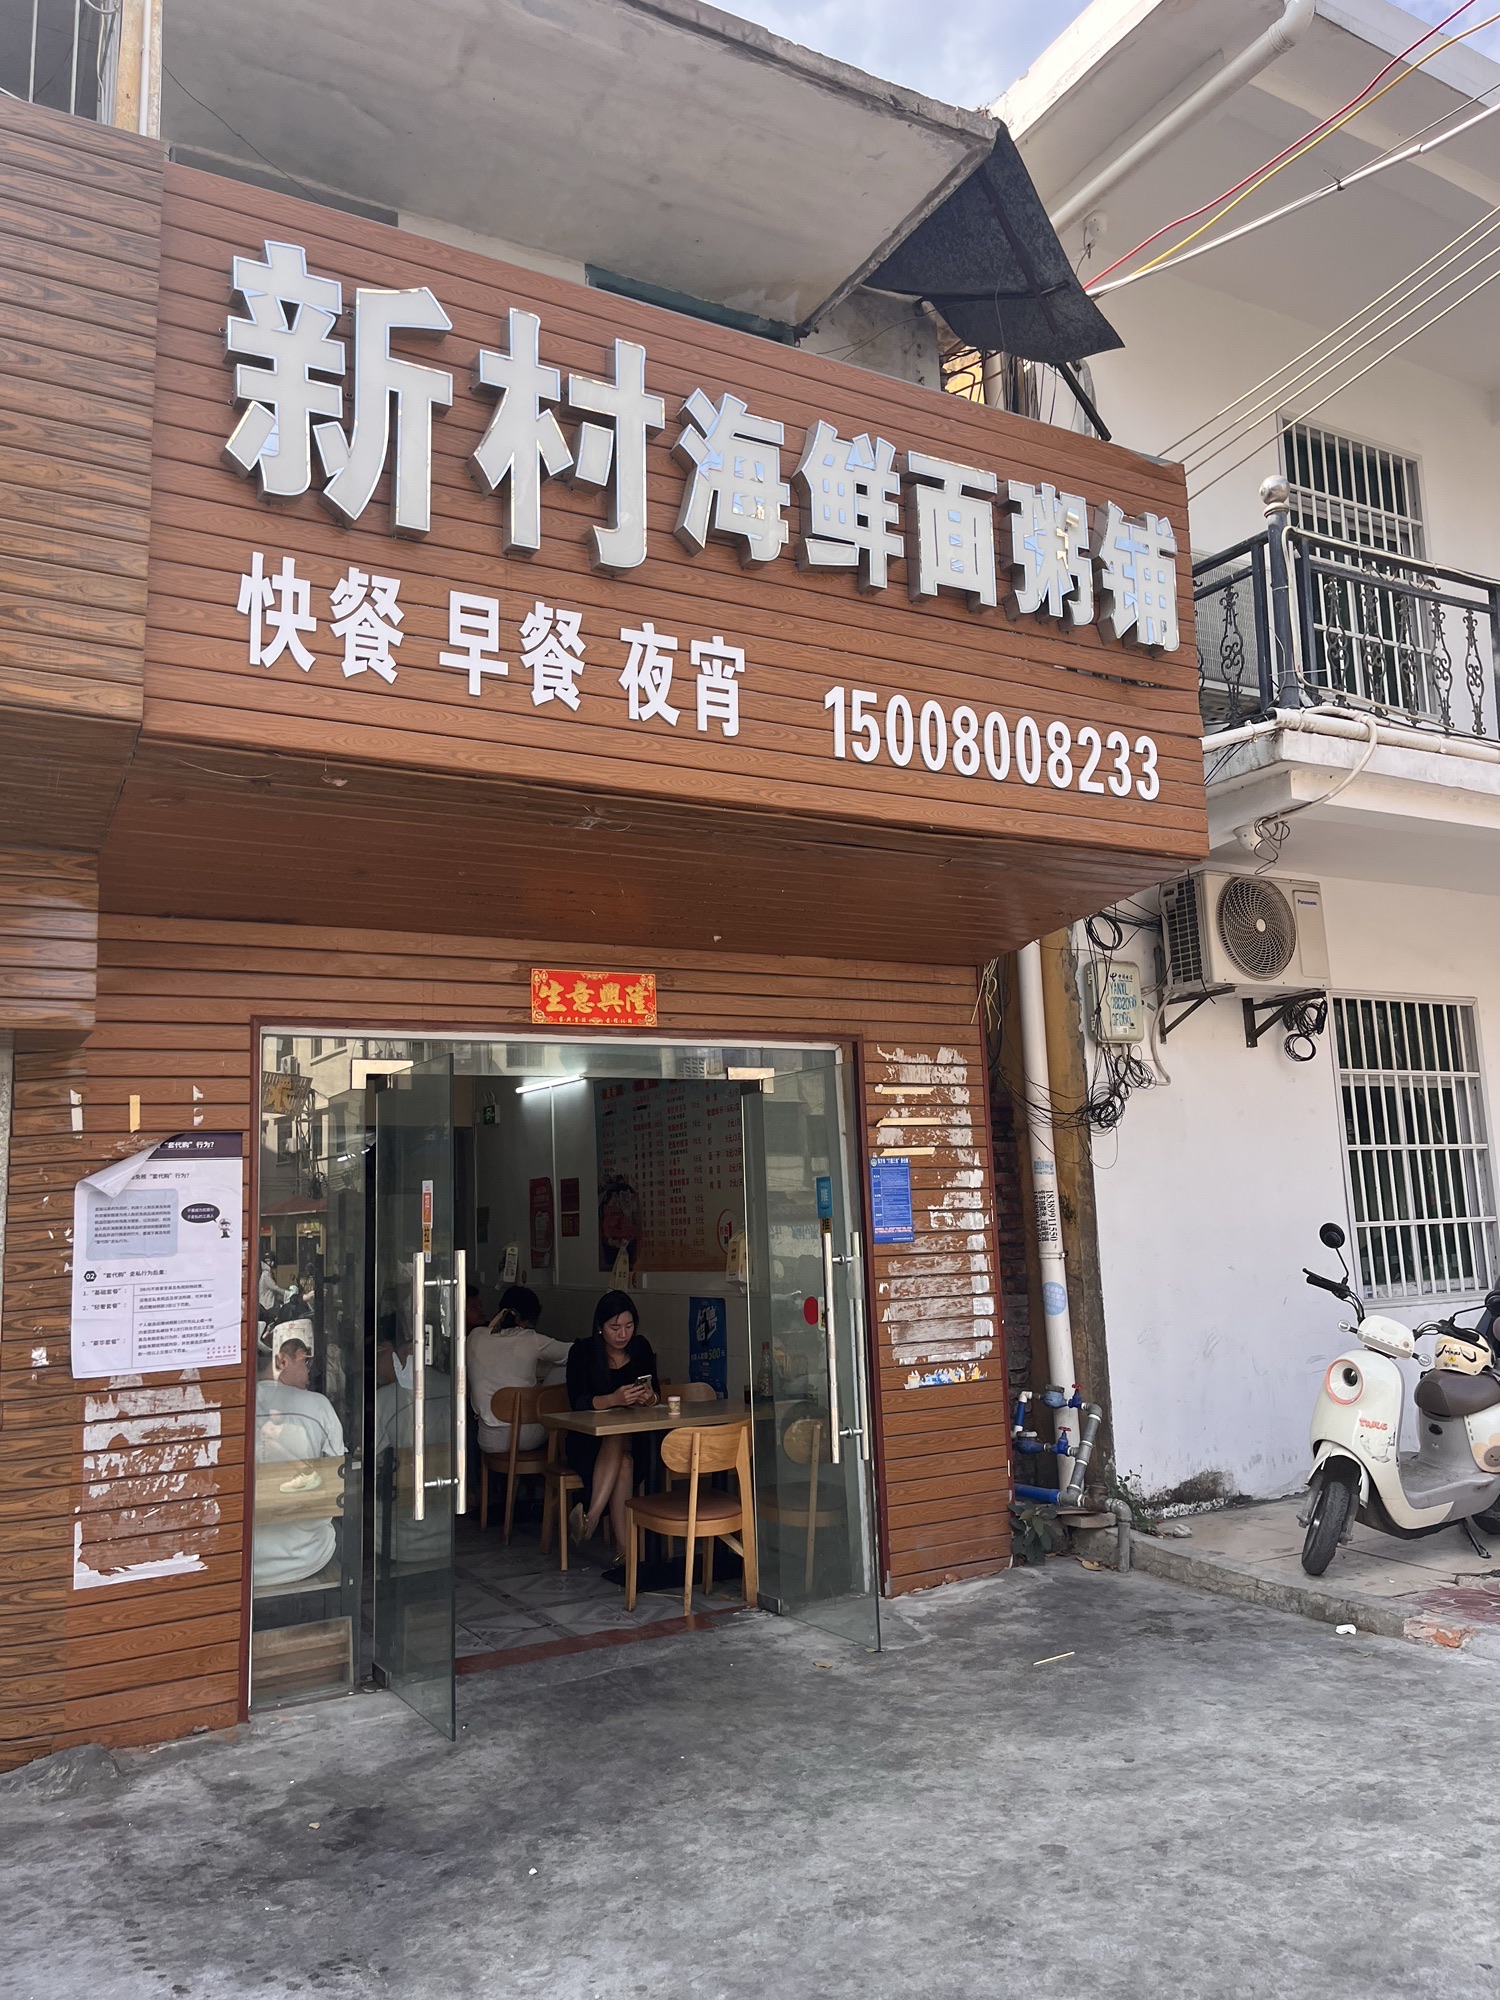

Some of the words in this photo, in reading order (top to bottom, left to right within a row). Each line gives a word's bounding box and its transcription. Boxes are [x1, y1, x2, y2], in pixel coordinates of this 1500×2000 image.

[226, 240, 1179, 652] 新村海鲜面粥铺
[237, 552, 404, 684] 快餐
[438, 590, 586, 712] 早餐
[618, 622, 746, 737] 夜宵
[824, 686, 1160, 800] 15008008233
[1046, 1190, 1058, 1242] 18389911550
